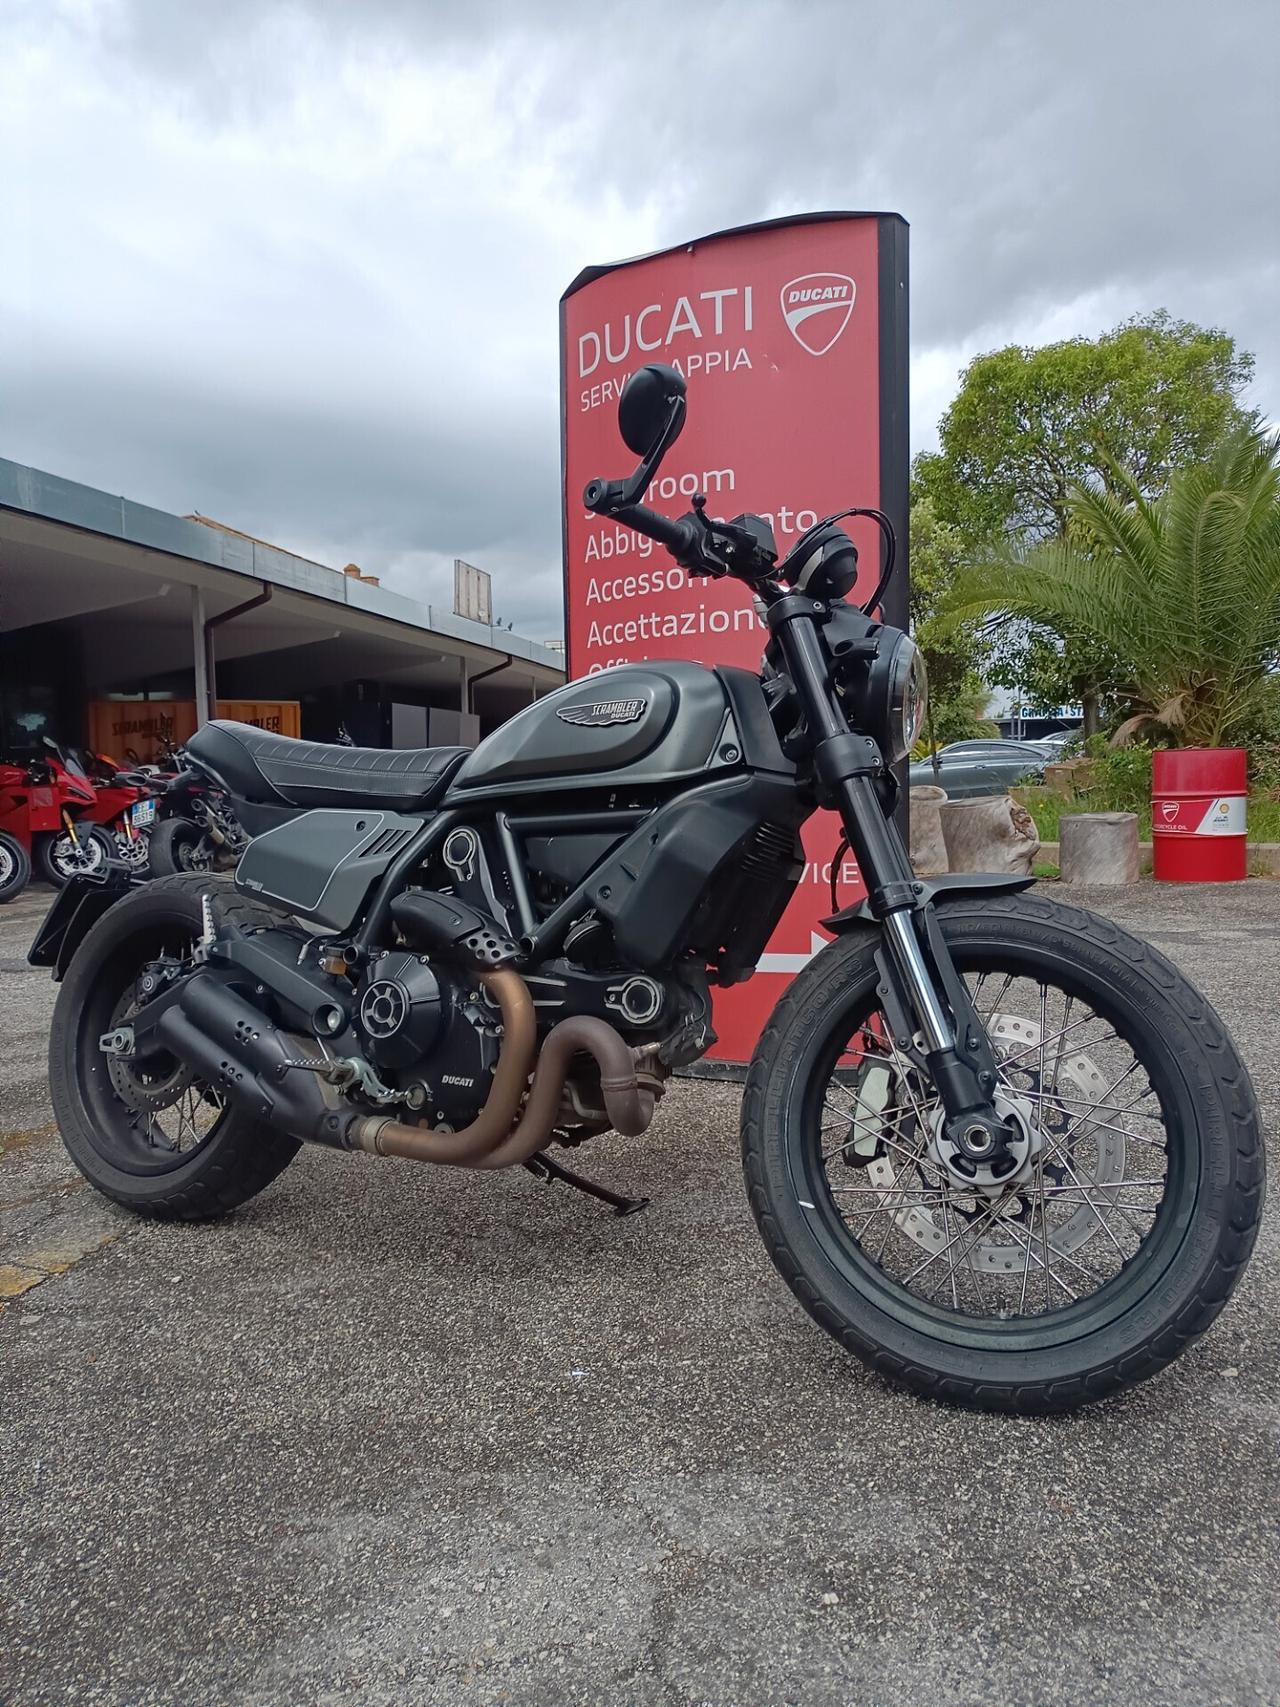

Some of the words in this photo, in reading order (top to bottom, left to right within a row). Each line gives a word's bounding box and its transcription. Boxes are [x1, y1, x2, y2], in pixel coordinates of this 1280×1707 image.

[788, 285, 848, 304] DUCATI
[578, 286, 753, 379] DUCATI
[581, 372, 631, 413] SERV
[671, 347, 753, 379] APPIA
[587, 604, 768, 649] Accettazion
[591, 701, 638, 716] SCRAMBLER
[611, 711, 635, 719] DUCATI
[441, 1074, 474, 1087] DUCATI
